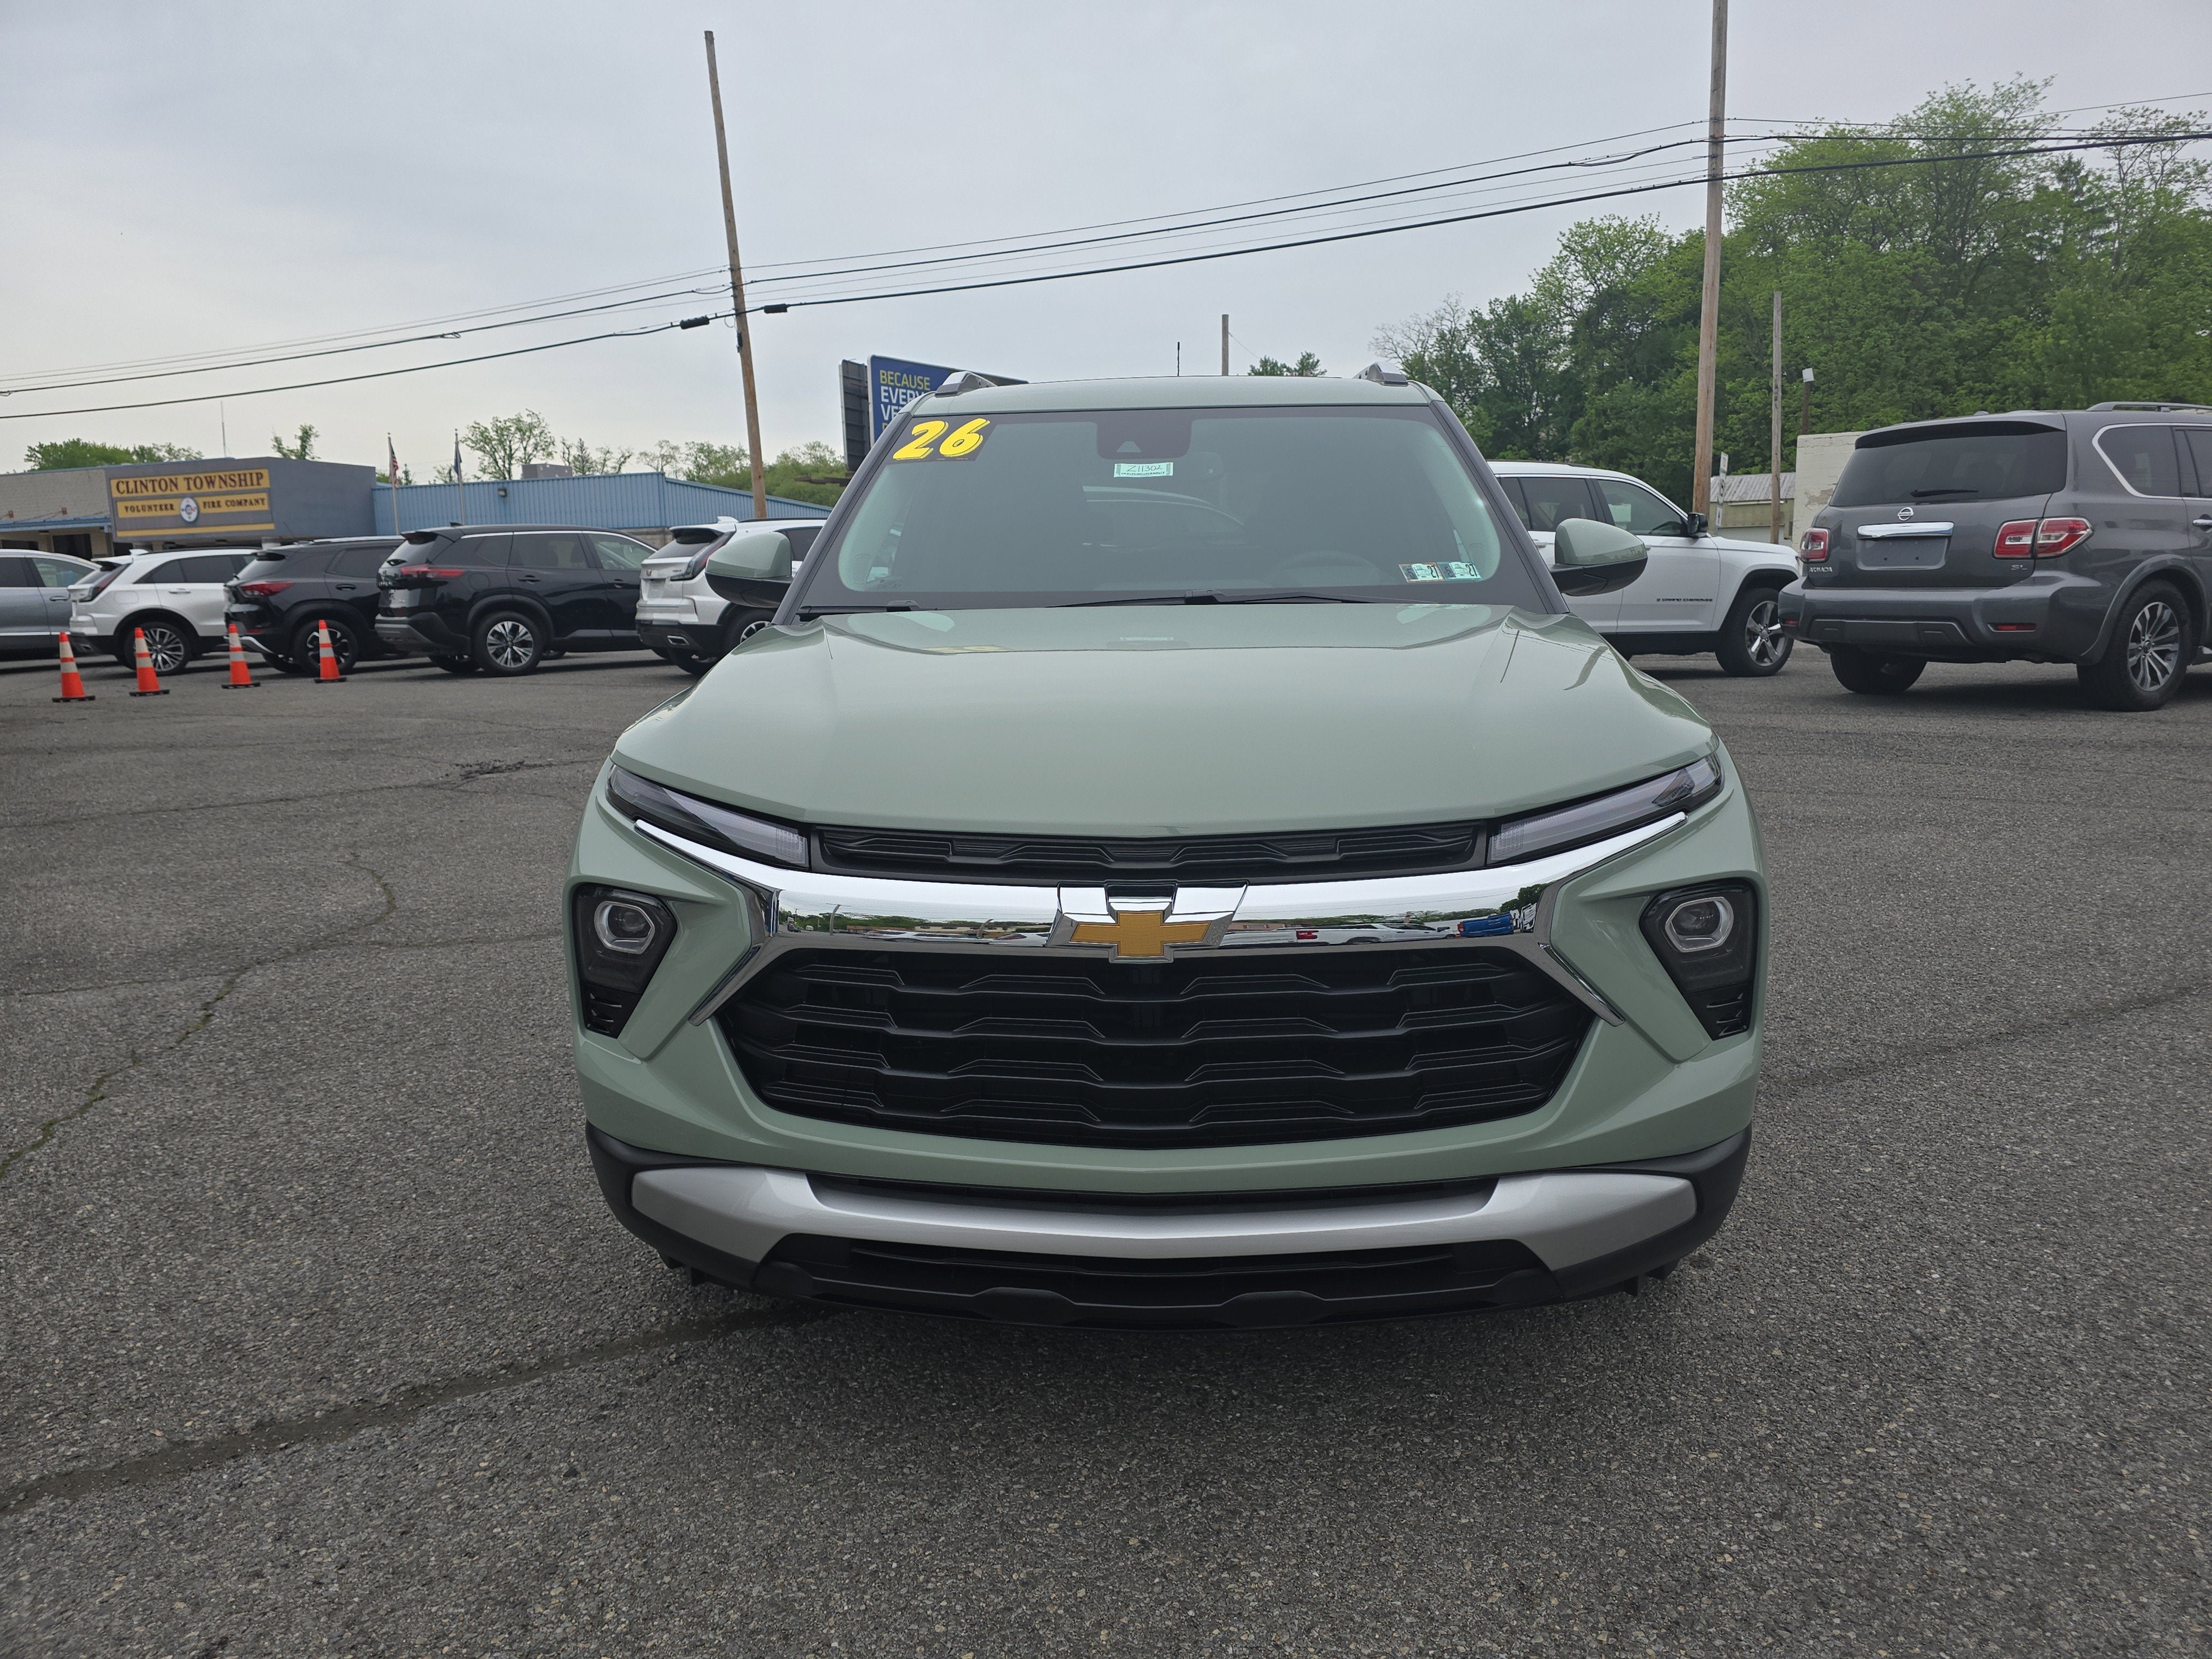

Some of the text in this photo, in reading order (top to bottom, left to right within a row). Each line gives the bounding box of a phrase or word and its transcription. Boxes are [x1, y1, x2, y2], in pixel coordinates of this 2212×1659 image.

[880, 370, 930, 390] BECAUSE
[893, 418, 991, 460] 26
[116, 472, 263, 494] CLINTON TOWNSHIP
[124, 497, 266, 513] VOLUNTEER FIRE COMPANY
[1427, 565, 1439, 578] 27
[1465, 564, 1477, 577] 27
